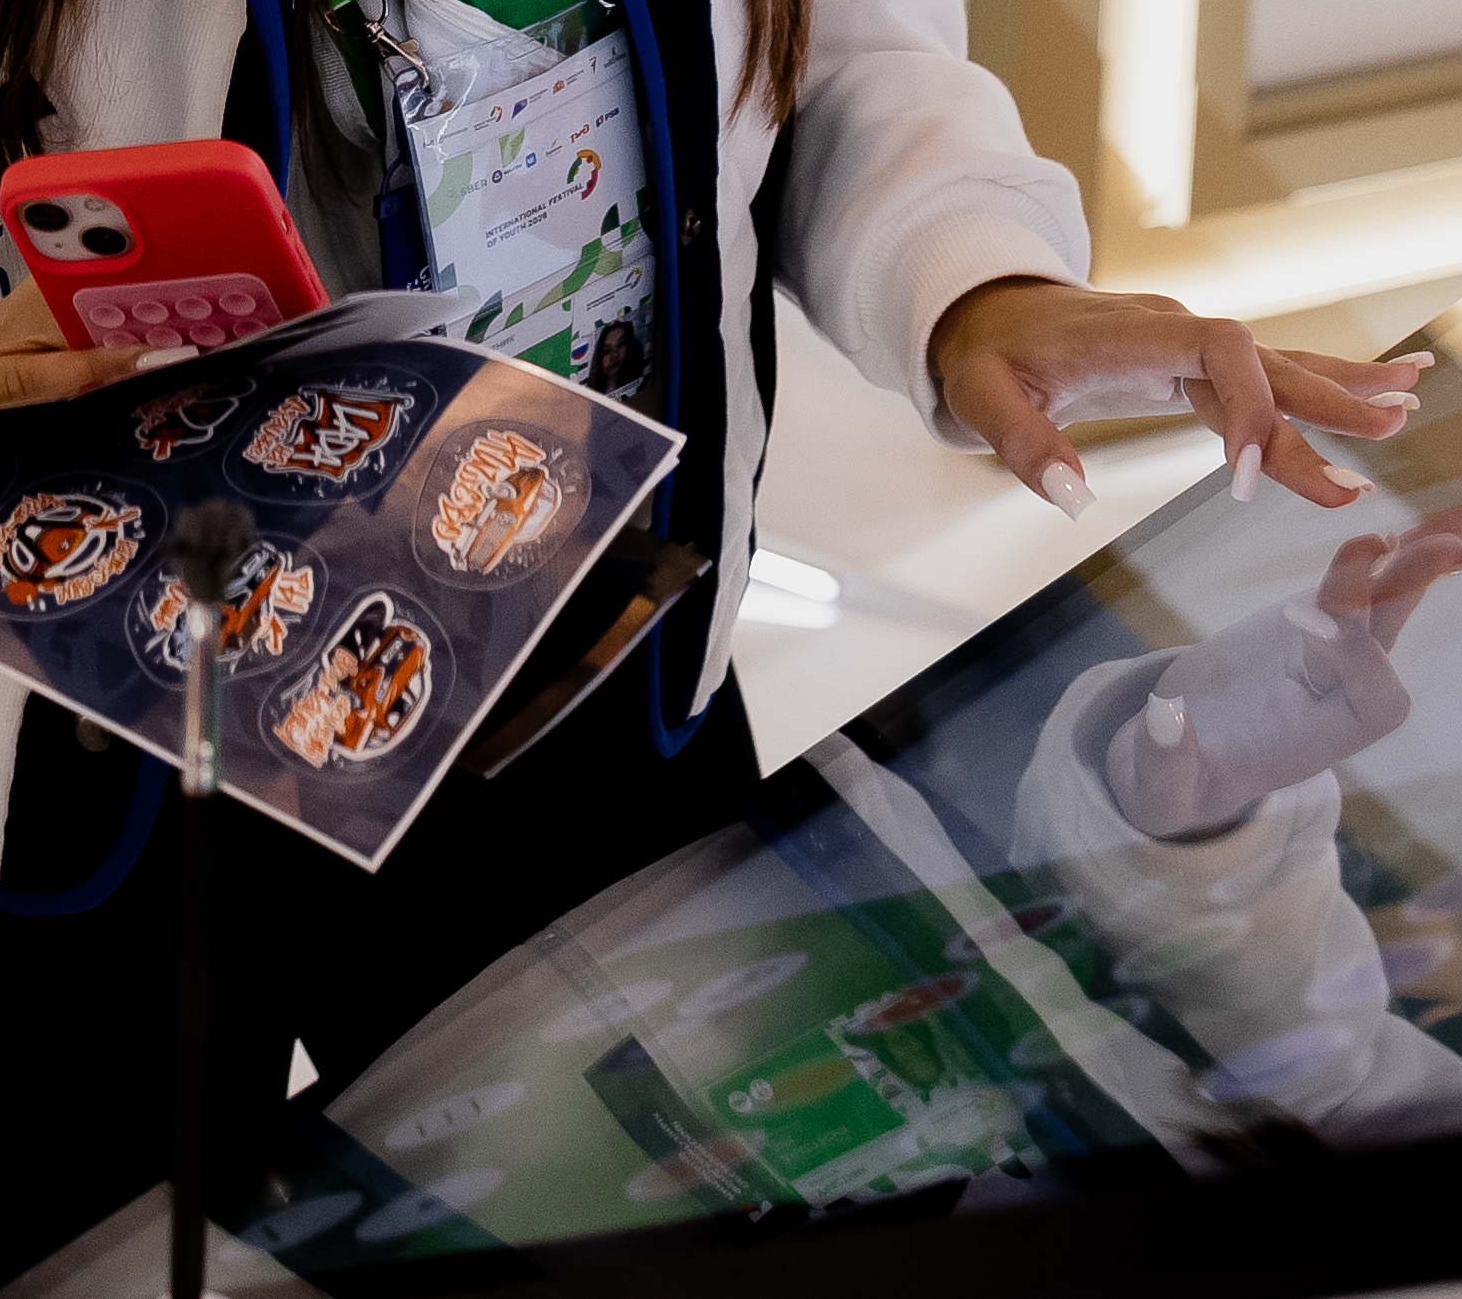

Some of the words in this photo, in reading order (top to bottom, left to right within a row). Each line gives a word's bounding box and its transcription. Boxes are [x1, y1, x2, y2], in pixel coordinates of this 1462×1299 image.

[485, 202, 546, 240] INTERNATIONAL
[548, 183, 584, 207] FESTIVAL
[486, 236, 498, 249] OF
[499, 222, 527, 245] YOUTH
